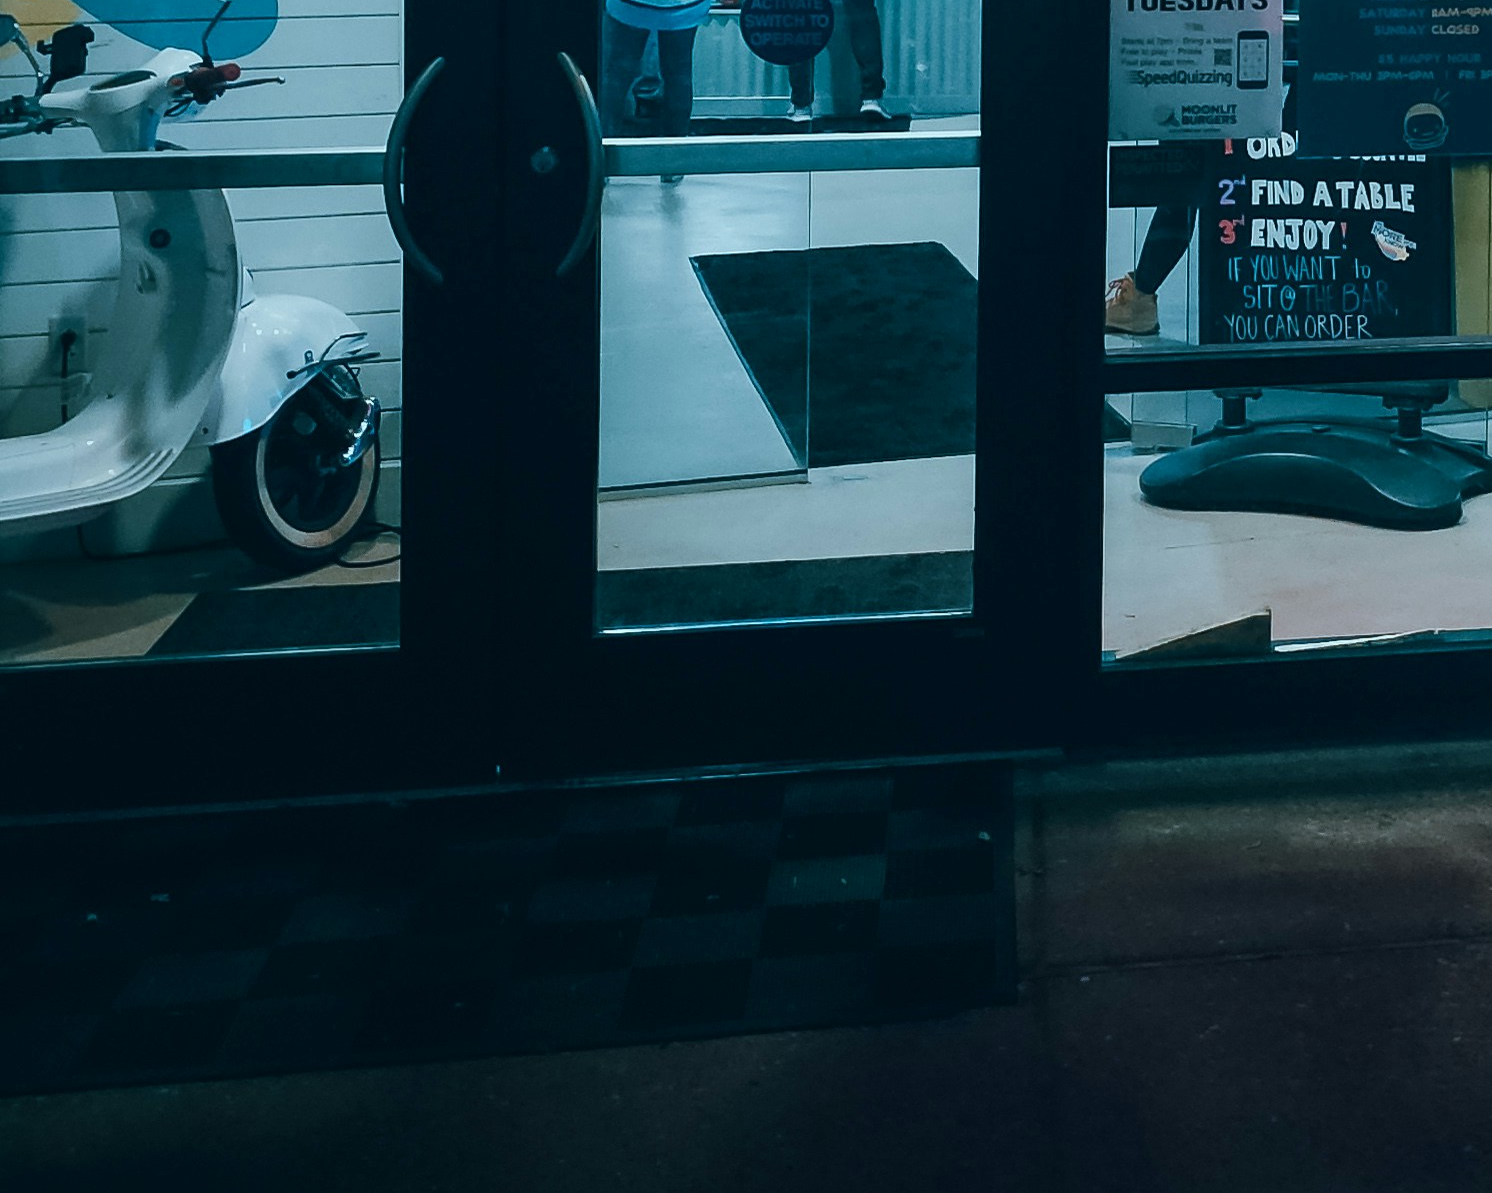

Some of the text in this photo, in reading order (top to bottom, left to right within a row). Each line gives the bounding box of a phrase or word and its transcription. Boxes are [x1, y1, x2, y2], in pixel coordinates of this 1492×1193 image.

[1359, 8, 1426, 18] SATURDAY
[745, 14, 829, 29] SWITCH TO
[1374, 25, 1480, 35] SUNDAY CLOSED
[750, 31, 823, 46] OPERATE
[1400, 53, 1442, 64] HAPPY
[1447, 53, 1482, 64] HOUR
[1137, 70, 1233, 87] SpeedQuizzing
[1312, 71, 1371, 81] MON-THU
[1181, 104, 1237, 114] MOONLIT
[1181, 115, 1237, 124] BURGERS
[1218, 174, 1415, 212] 2nd FIND A TABLE
[1228, 257, 1242, 281] IF
[1251, 258, 1279, 281] YOU
[1283, 255, 1342, 282] WANT
[1243, 285, 1278, 309] SIT
[1280, 285, 1296, 310] @
[1298, 285, 1334, 309] THE
[1223, 314, 1373, 340] YOU CAN ORDER
